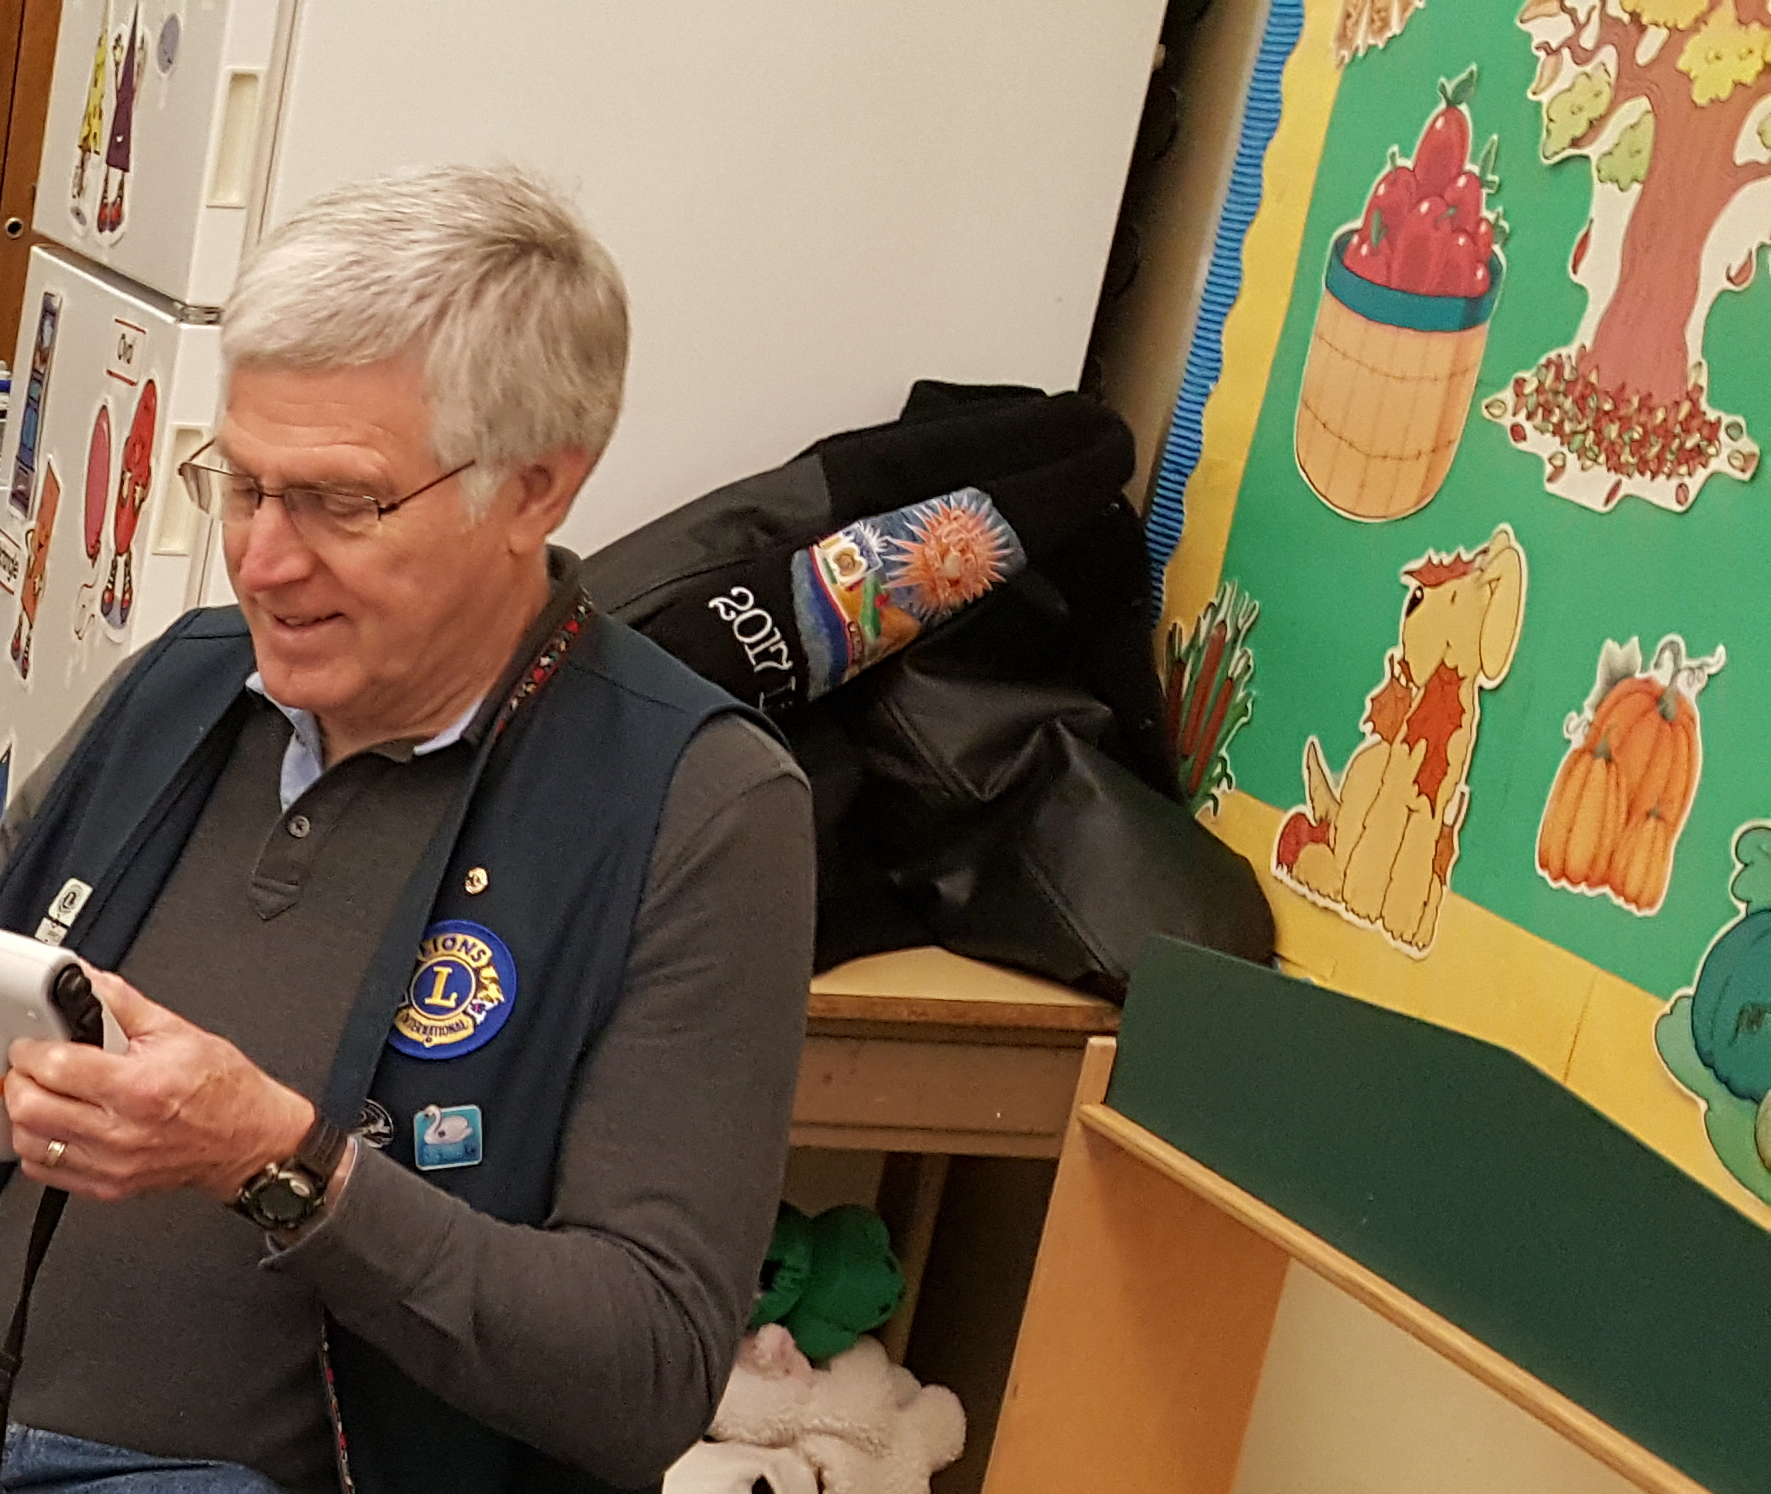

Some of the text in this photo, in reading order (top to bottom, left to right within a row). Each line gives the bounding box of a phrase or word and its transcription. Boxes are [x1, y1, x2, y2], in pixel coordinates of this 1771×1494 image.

[708, 586, 795, 674] 2017
[420, 936, 487, 963] LIONS
[425, 965, 458, 1008] L
